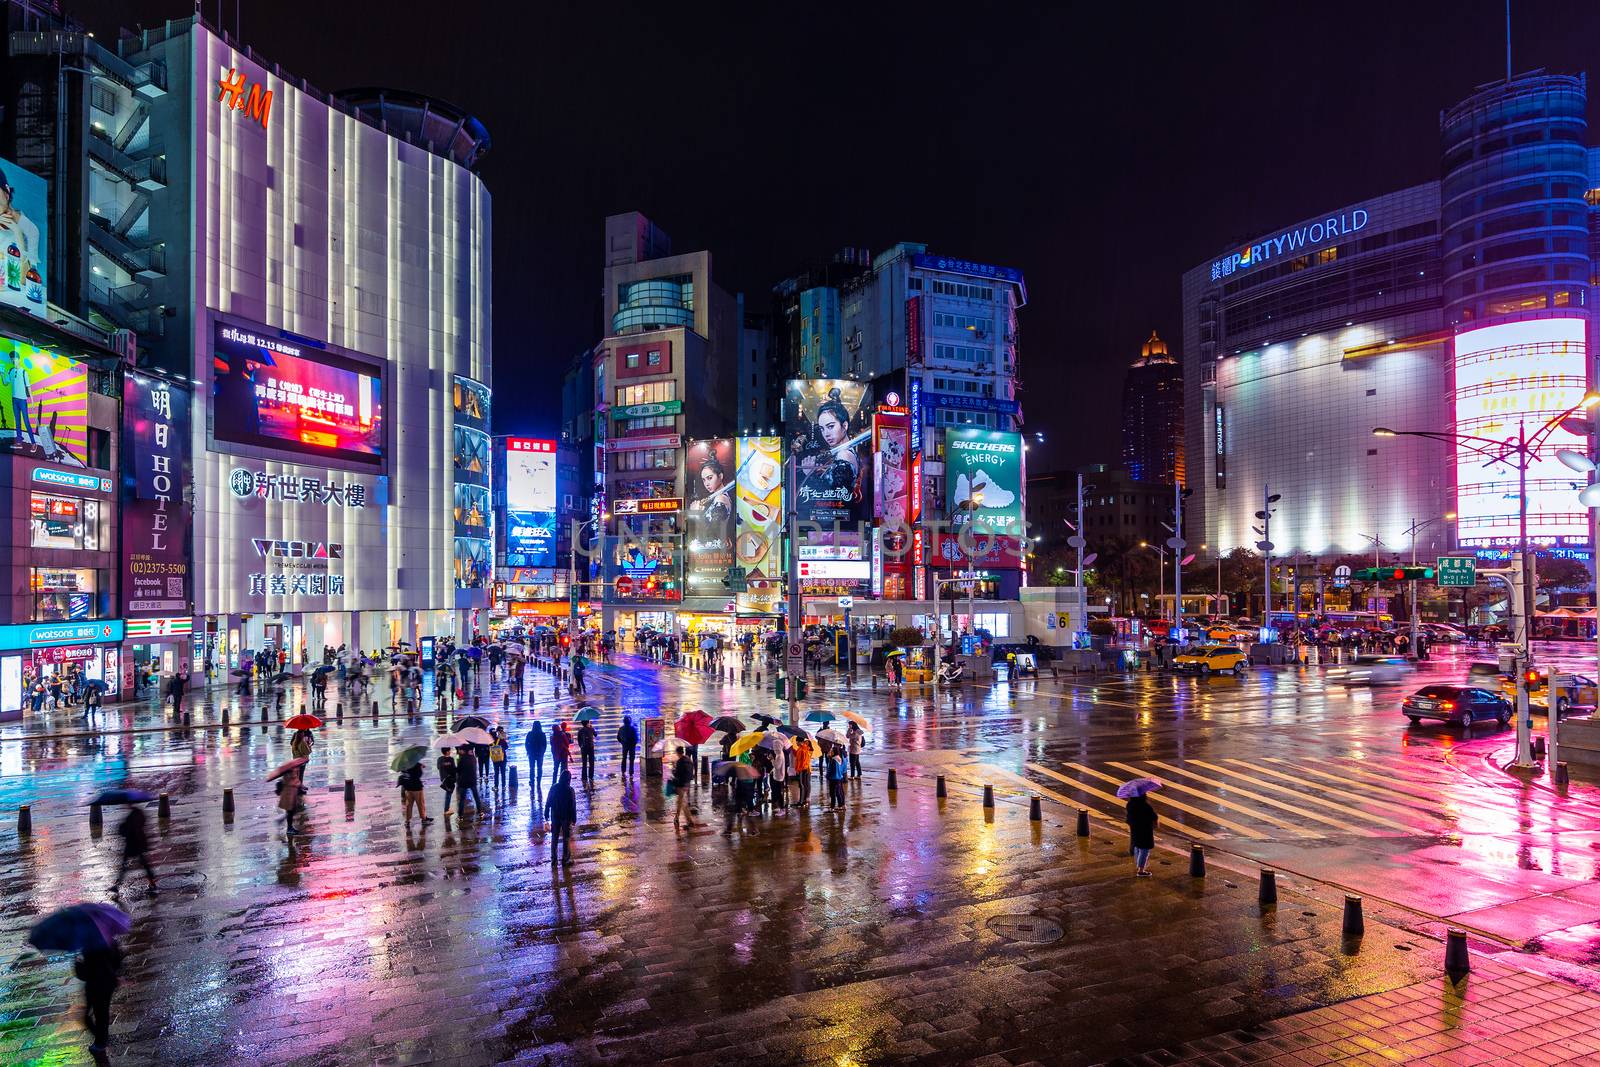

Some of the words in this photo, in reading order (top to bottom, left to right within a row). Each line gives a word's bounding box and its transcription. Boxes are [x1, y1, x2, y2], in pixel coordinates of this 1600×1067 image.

[217, 68, 274, 129] H&M
[151, 390, 172, 449] 明日
[952, 440, 1016, 453] SKECHERS
[966, 453, 1006, 467] ENERGY
[39, 472, 75, 484] watsons
[255, 472, 366, 508] 新世界大樓
[151, 455, 172, 550] HOTEL
[130, 561, 186, 574] (02)2375-5500
[248, 574, 345, 596] 真善美劇院
[1058, 617, 1066, 628] 6
[35, 629, 74, 639] watsons
